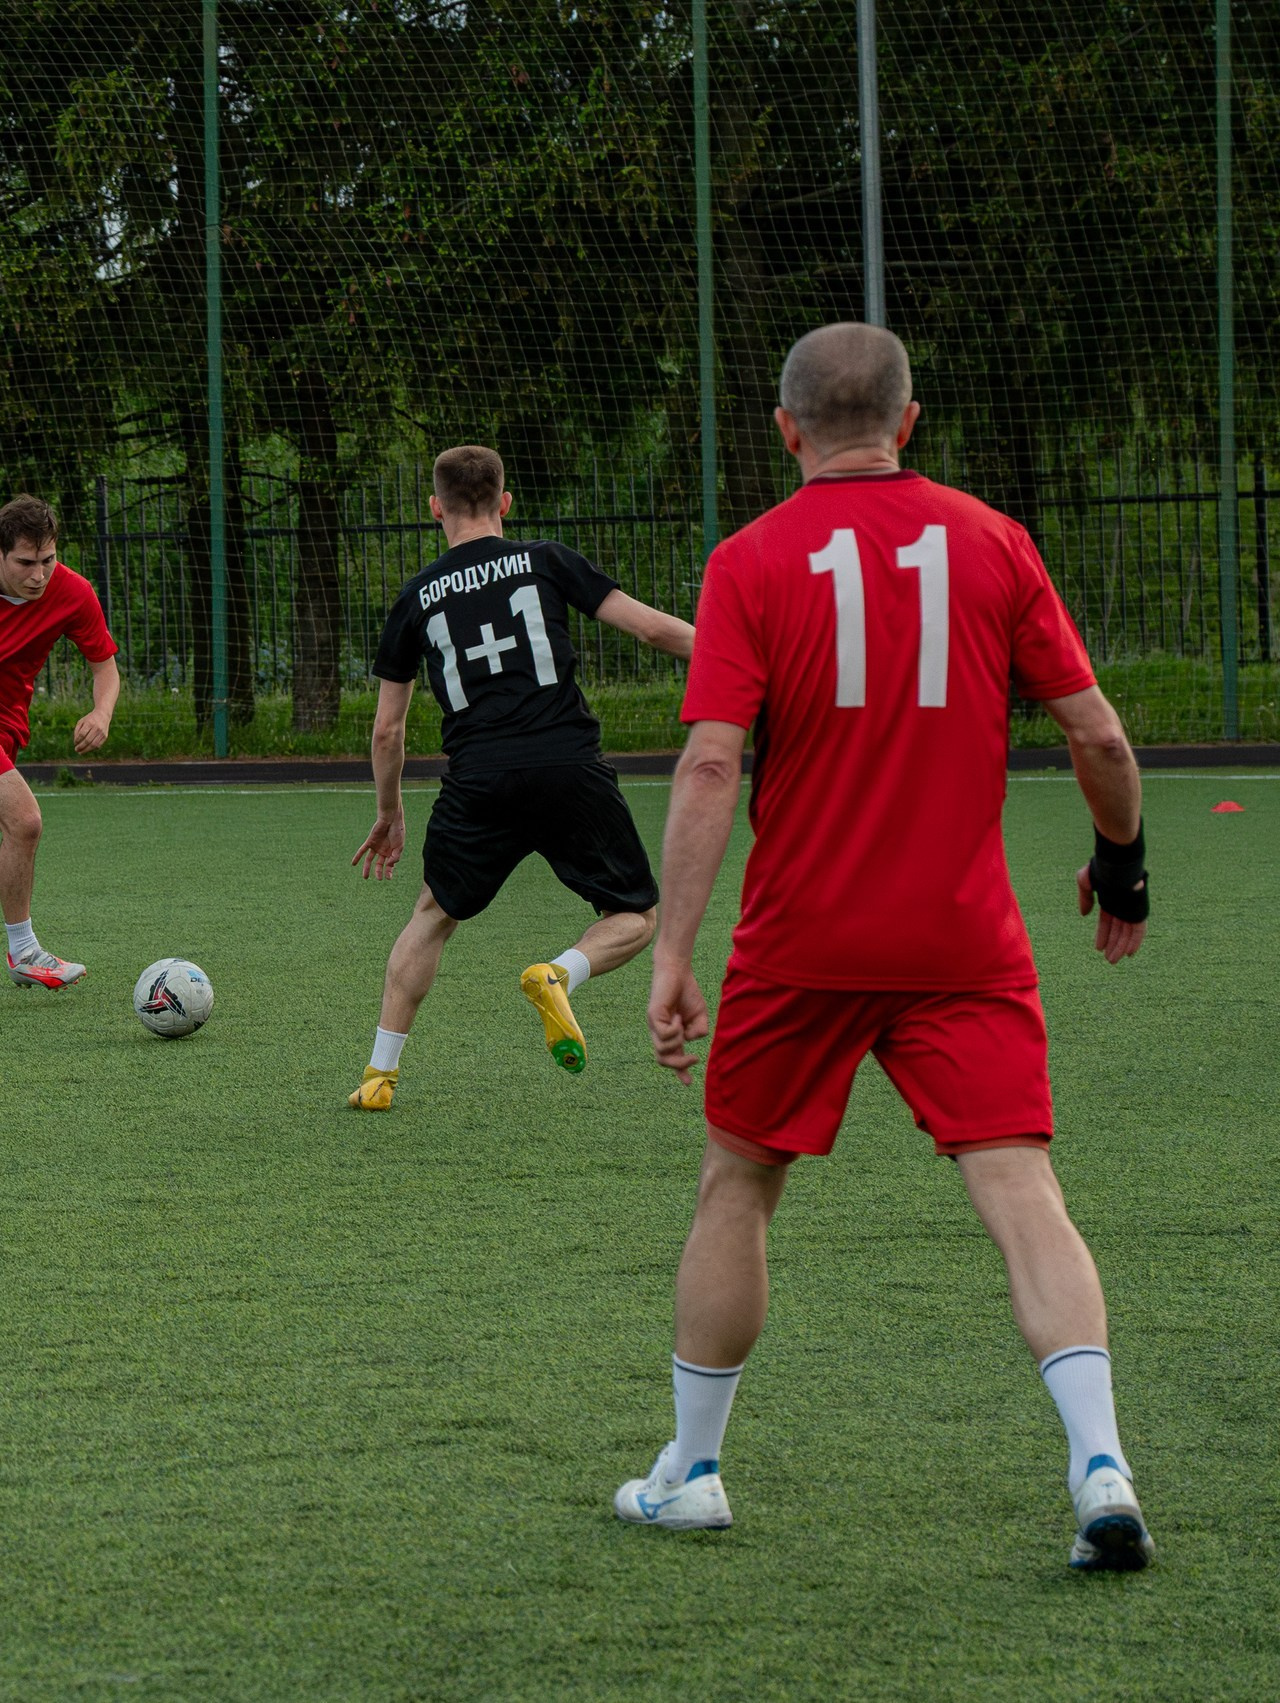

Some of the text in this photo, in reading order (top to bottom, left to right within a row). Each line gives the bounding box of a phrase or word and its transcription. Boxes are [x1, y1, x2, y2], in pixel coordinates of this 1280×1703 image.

[419, 551, 533, 611] БОРОДУХИН
[808, 524, 950, 708] 11
[426, 584, 559, 712] 1+1
